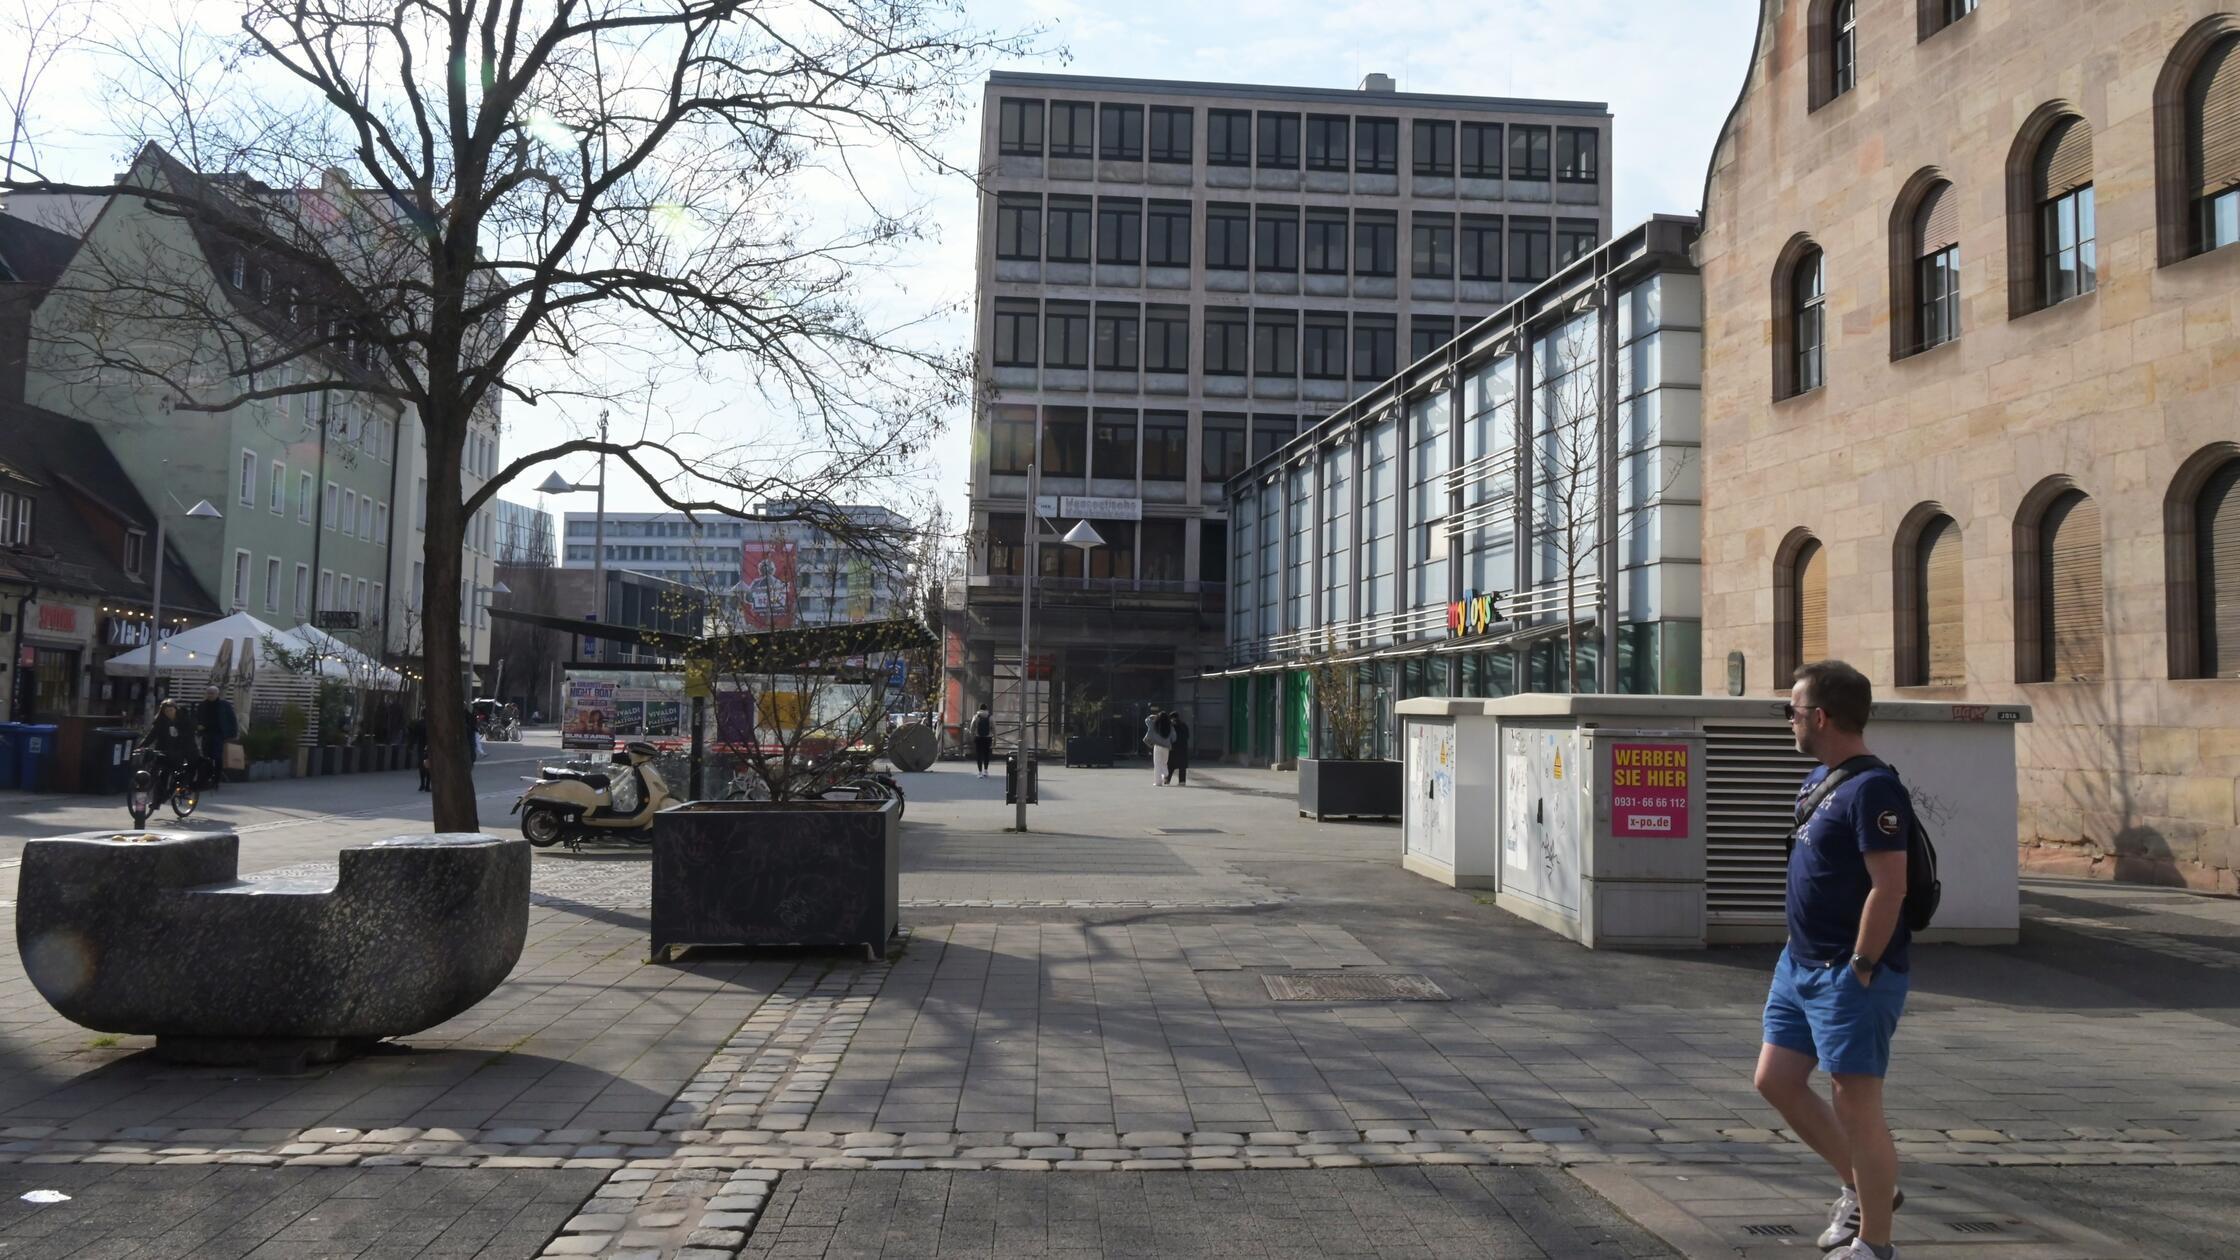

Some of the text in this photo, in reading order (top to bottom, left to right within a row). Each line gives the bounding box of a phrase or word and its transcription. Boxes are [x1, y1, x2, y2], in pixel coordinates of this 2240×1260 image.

[570, 687, 613, 698] NIGHT BOAT
[648, 707, 677, 718] VIVALDI
[1615, 749, 1686, 767] WERBEN
[1614, 769, 1686, 787] SIE HIER
[1656, 797, 1667, 808] 66
[1670, 797, 1686, 808] 112
[1630, 816, 1669, 828] x-po.de
